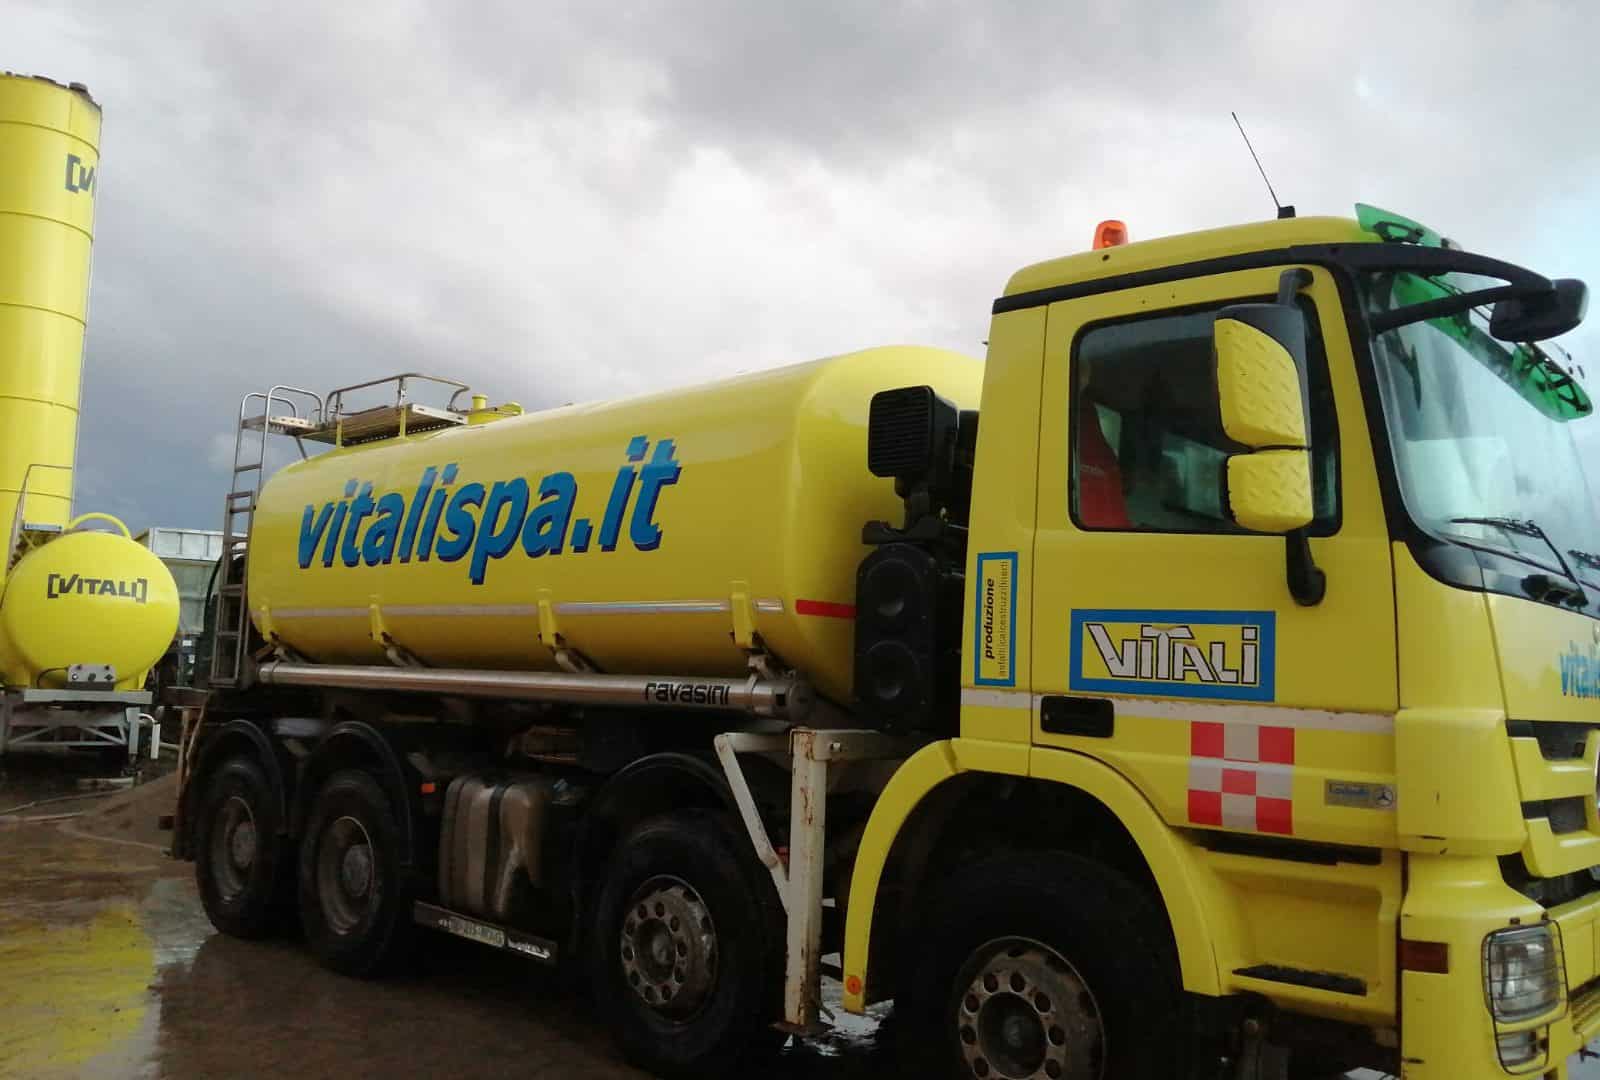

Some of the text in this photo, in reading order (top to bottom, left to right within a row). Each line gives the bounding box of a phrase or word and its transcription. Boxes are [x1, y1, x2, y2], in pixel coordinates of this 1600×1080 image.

[299, 436, 681, 584] vitalispa.it
[984, 578, 995, 659] produzione
[645, 682, 730, 704] ravasini
